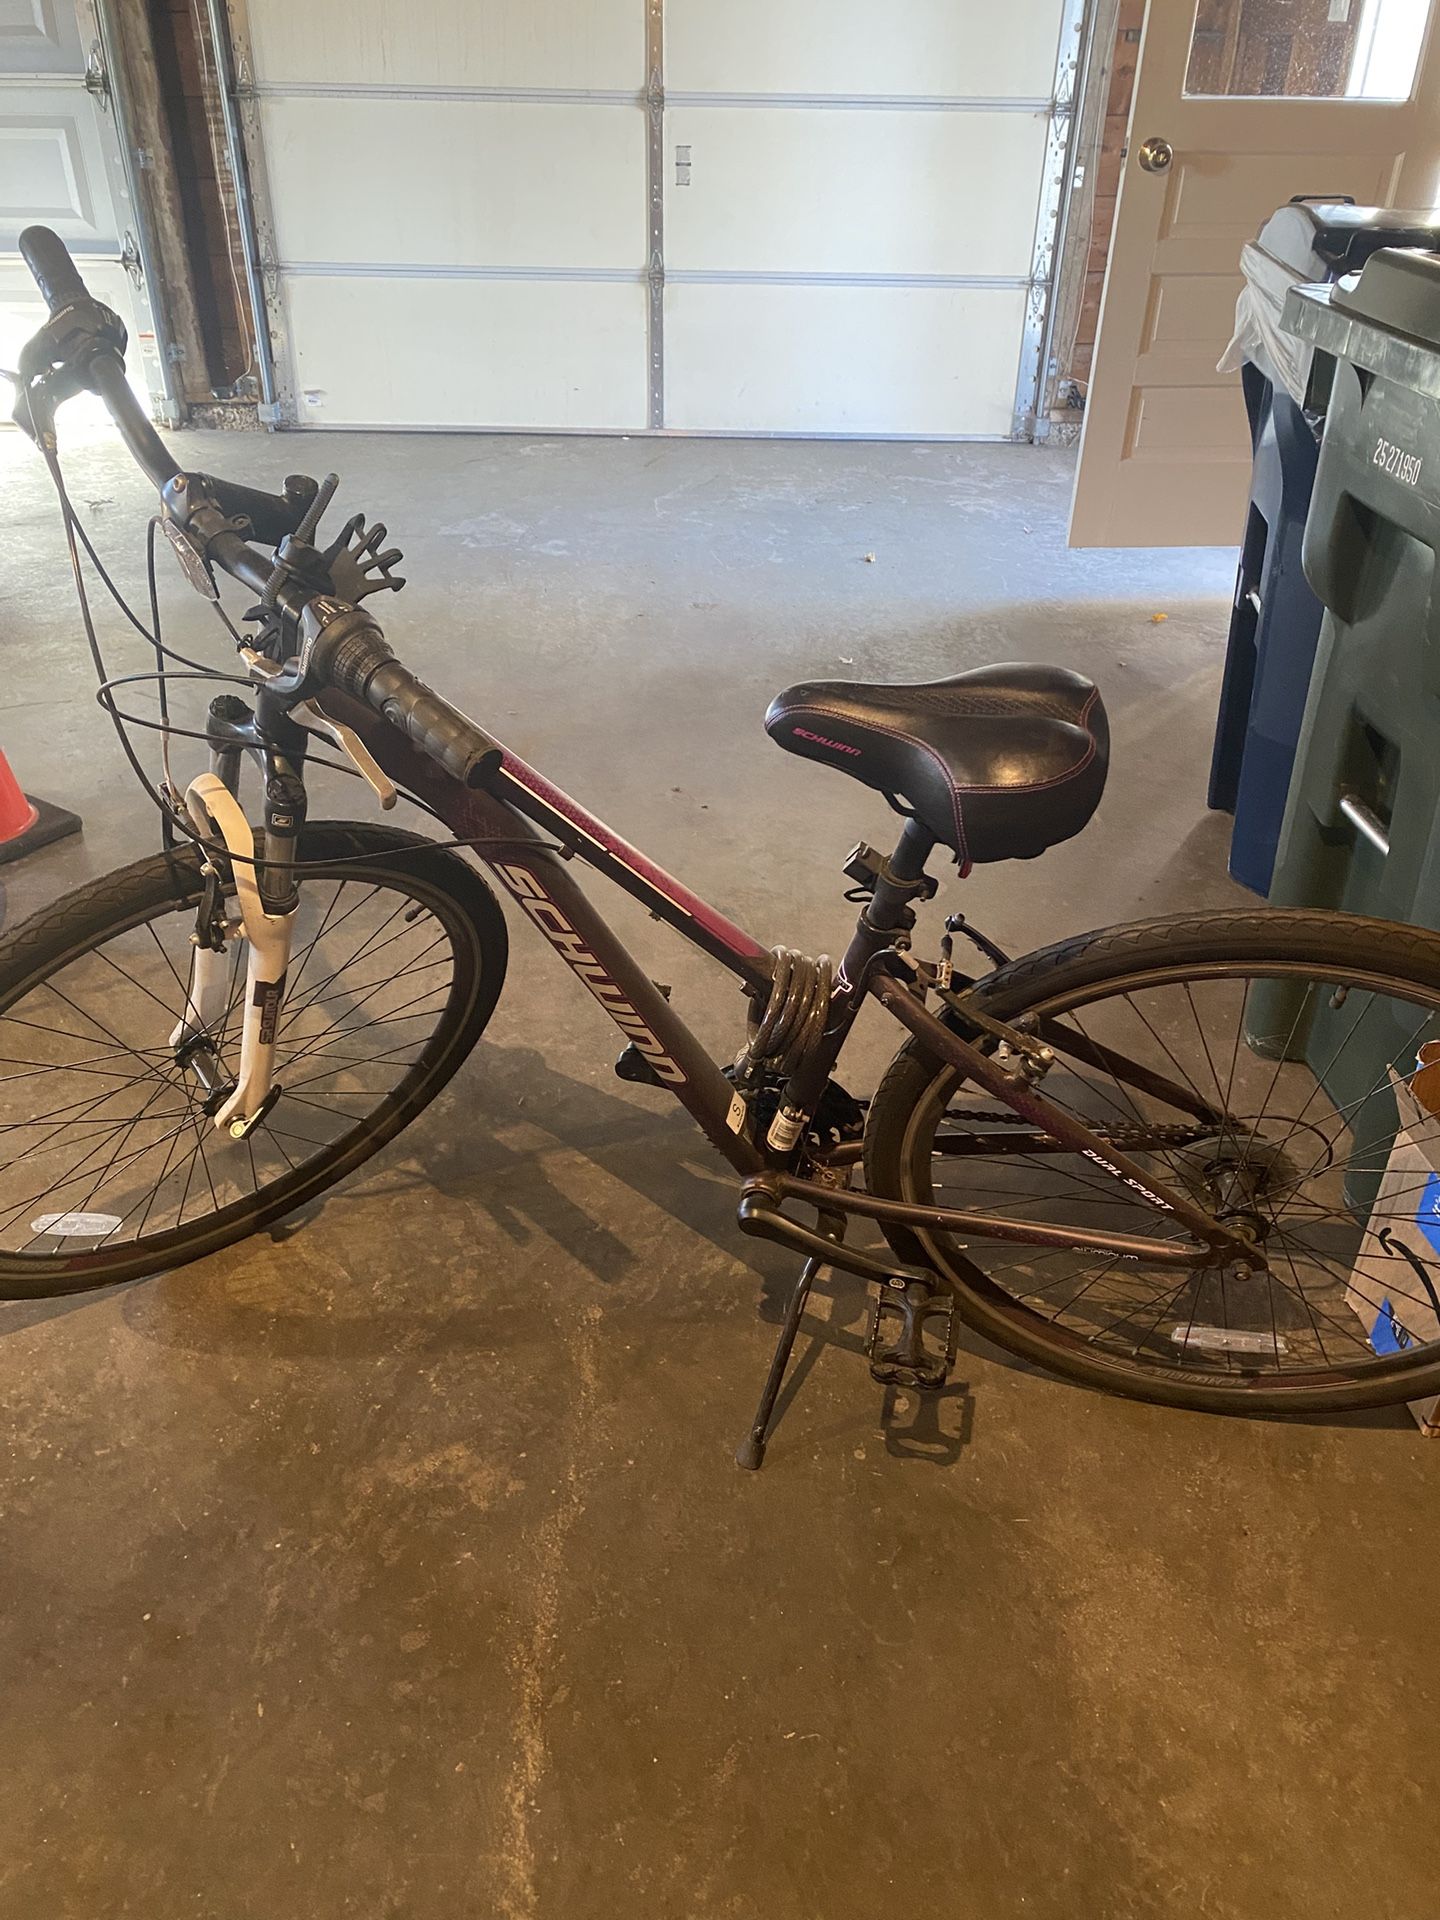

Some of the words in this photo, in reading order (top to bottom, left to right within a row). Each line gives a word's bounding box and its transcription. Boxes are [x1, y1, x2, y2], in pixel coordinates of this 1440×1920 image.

[792, 727, 862, 756] SCHWINN
[491, 862, 688, 1084] SCHWINN
[1081, 1149, 1122, 1177] DUAL
[1122, 1178, 1175, 1211] SPORT
